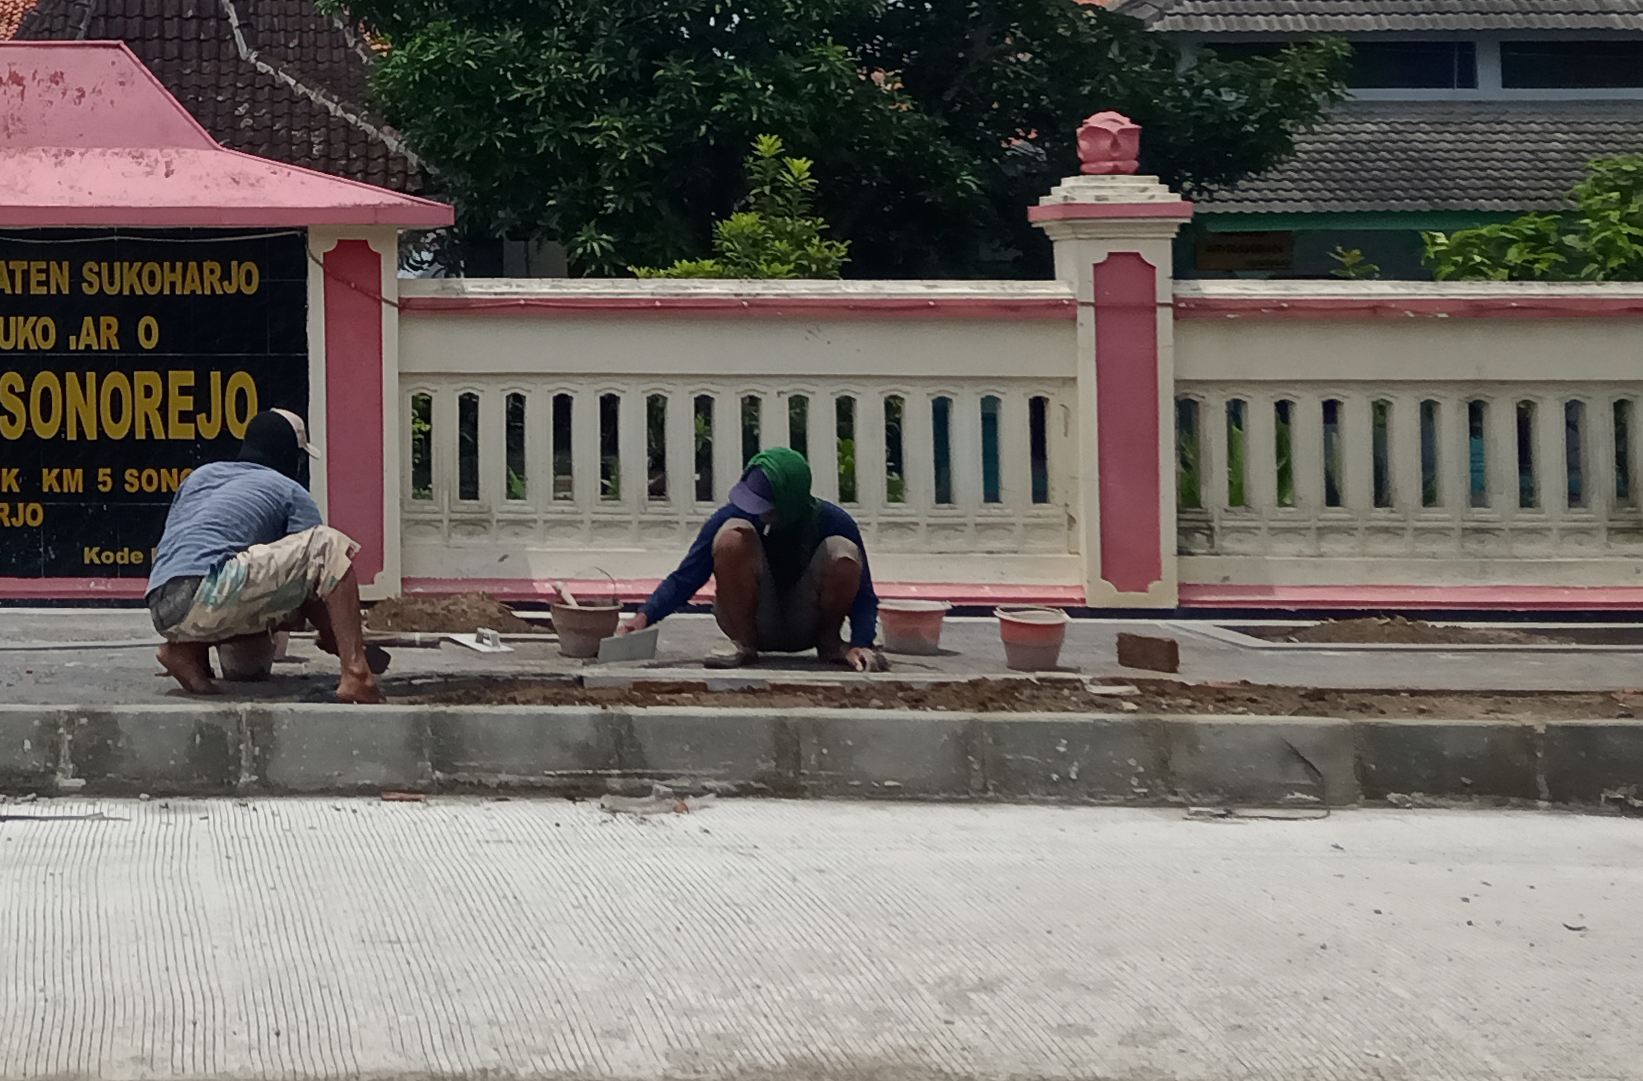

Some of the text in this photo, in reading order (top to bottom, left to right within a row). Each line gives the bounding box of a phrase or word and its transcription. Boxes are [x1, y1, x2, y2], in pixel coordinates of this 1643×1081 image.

[82, 260, 259, 295] SUKOHARJO
[42, 468, 83, 493] KM
[98, 467, 113, 492] 5
[84, 546, 143, 565] Kode
